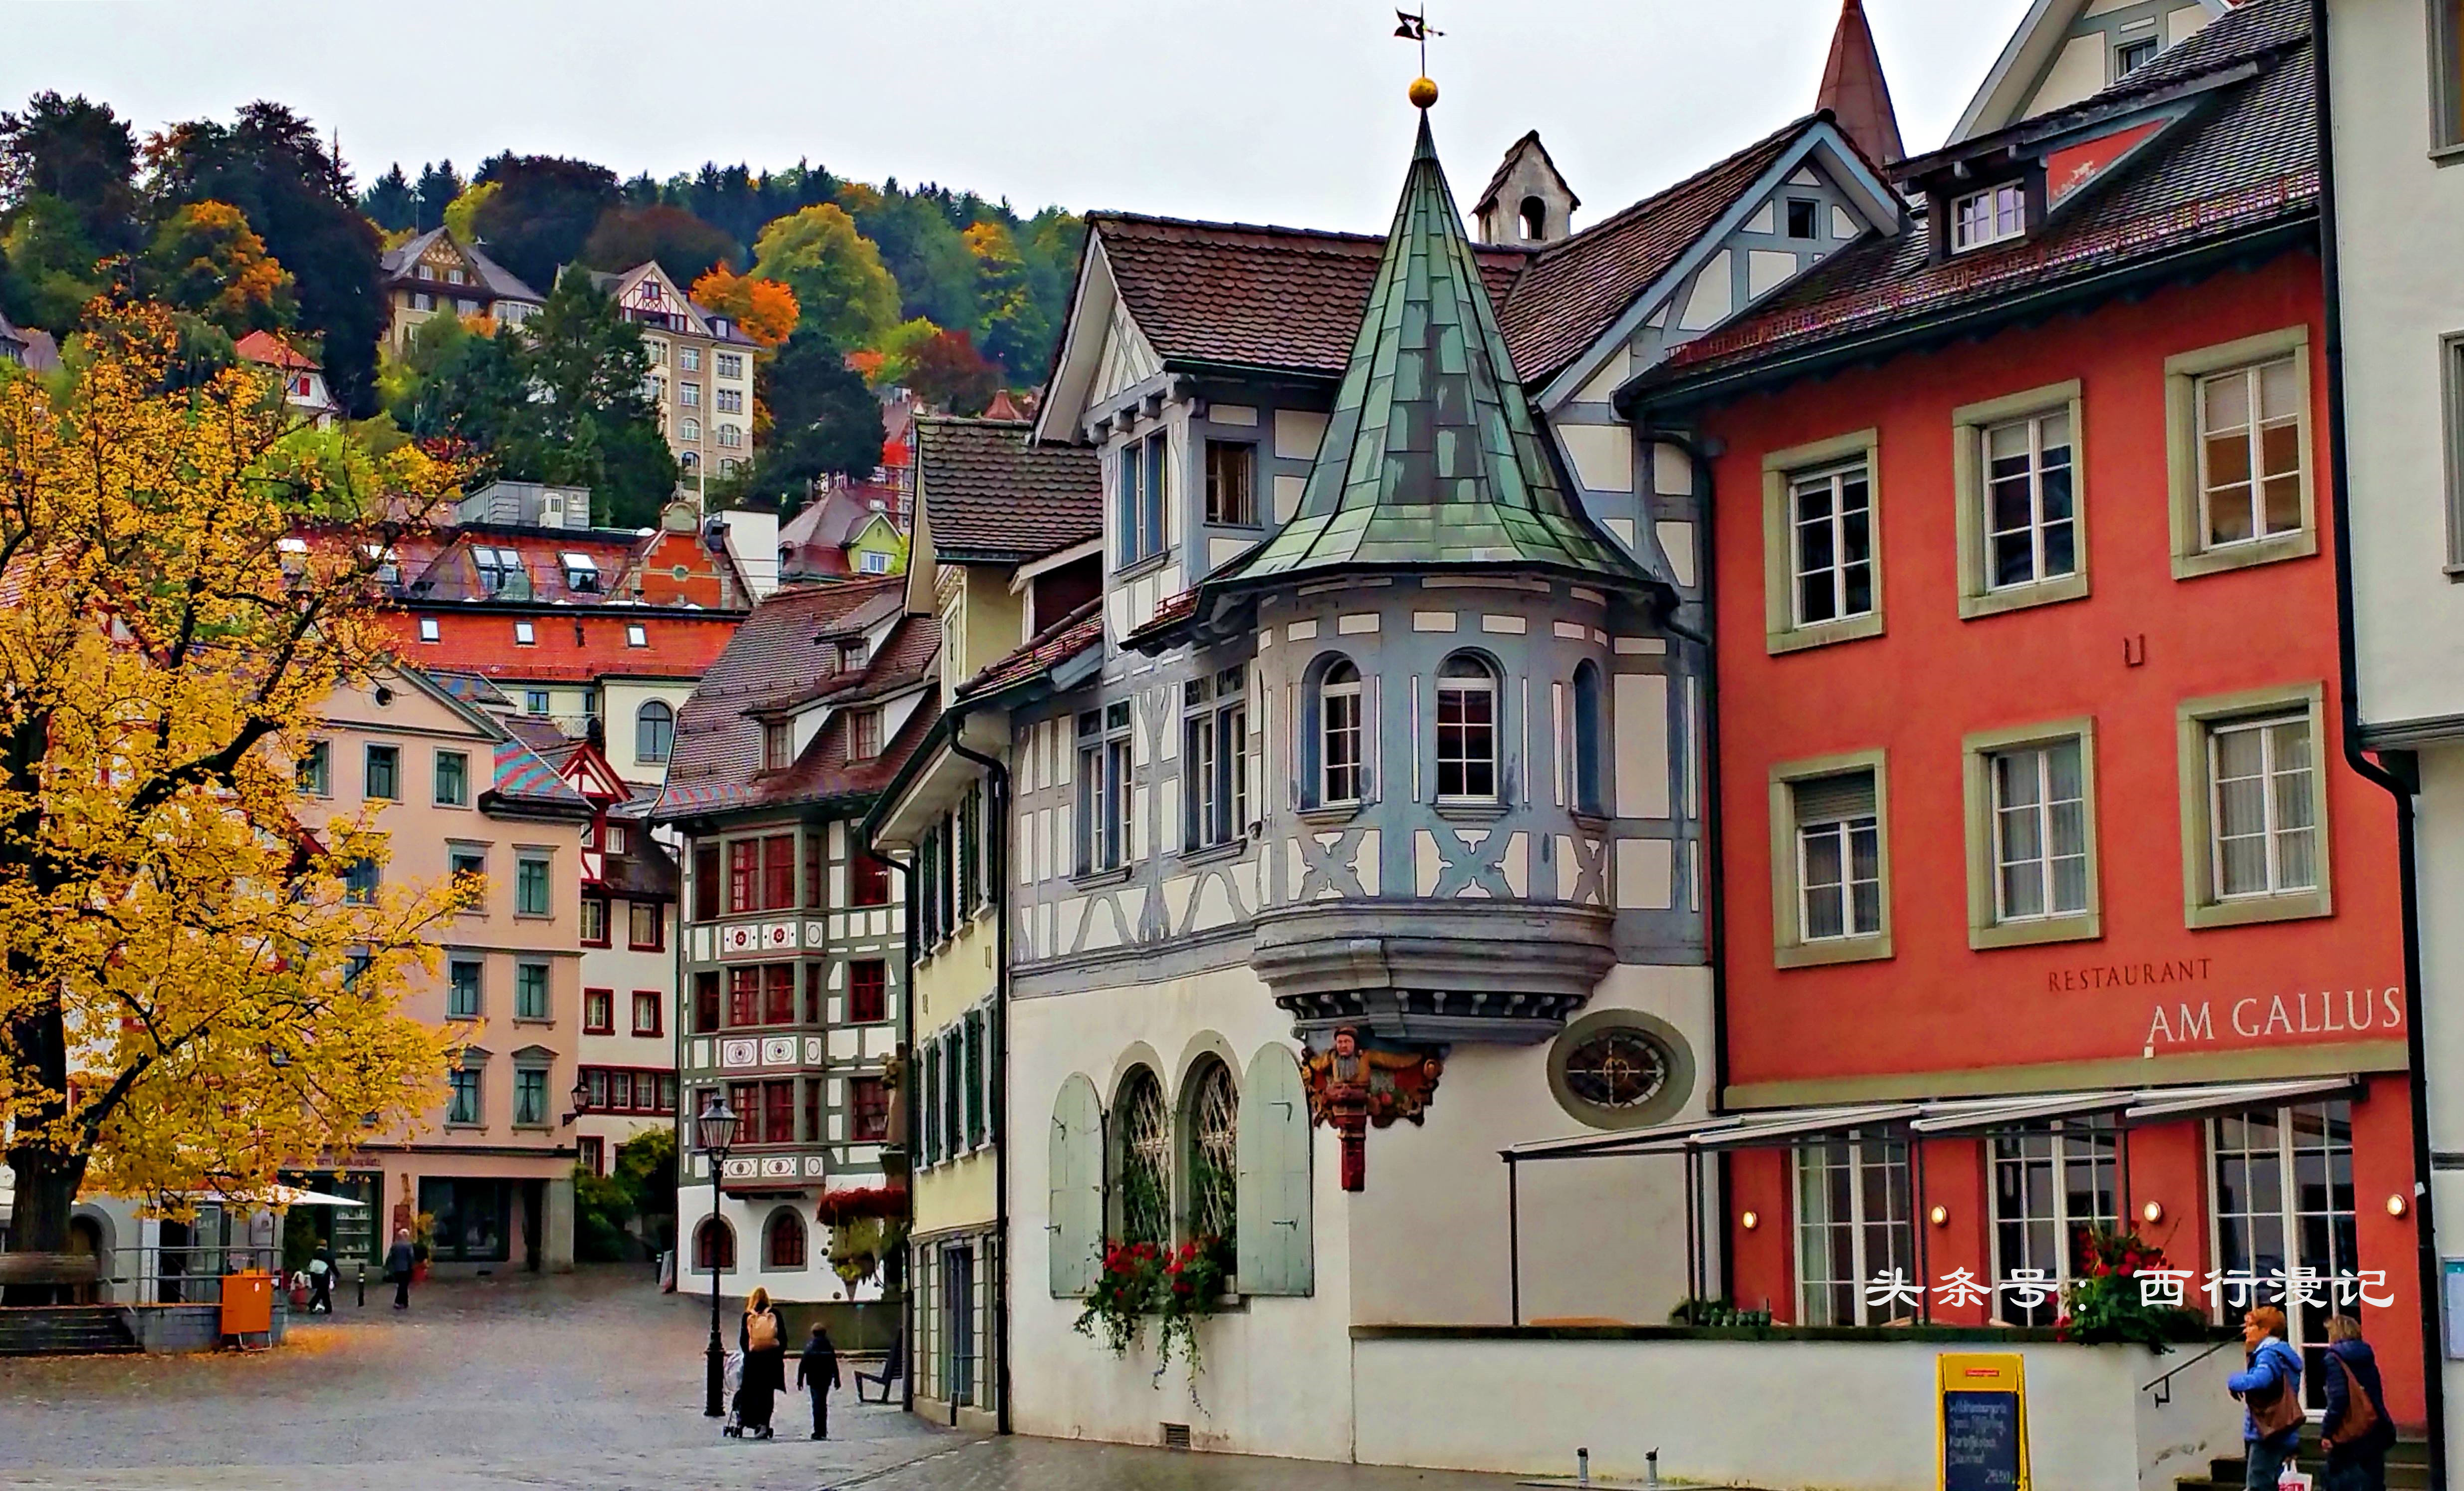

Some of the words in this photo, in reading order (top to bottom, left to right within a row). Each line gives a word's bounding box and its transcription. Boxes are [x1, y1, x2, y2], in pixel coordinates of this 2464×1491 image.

[2048, 958, 2212, 992] RESTAURANT
[2146, 1001, 2215, 1043] AM
[2232, 987, 2401, 1037] GALLUS
